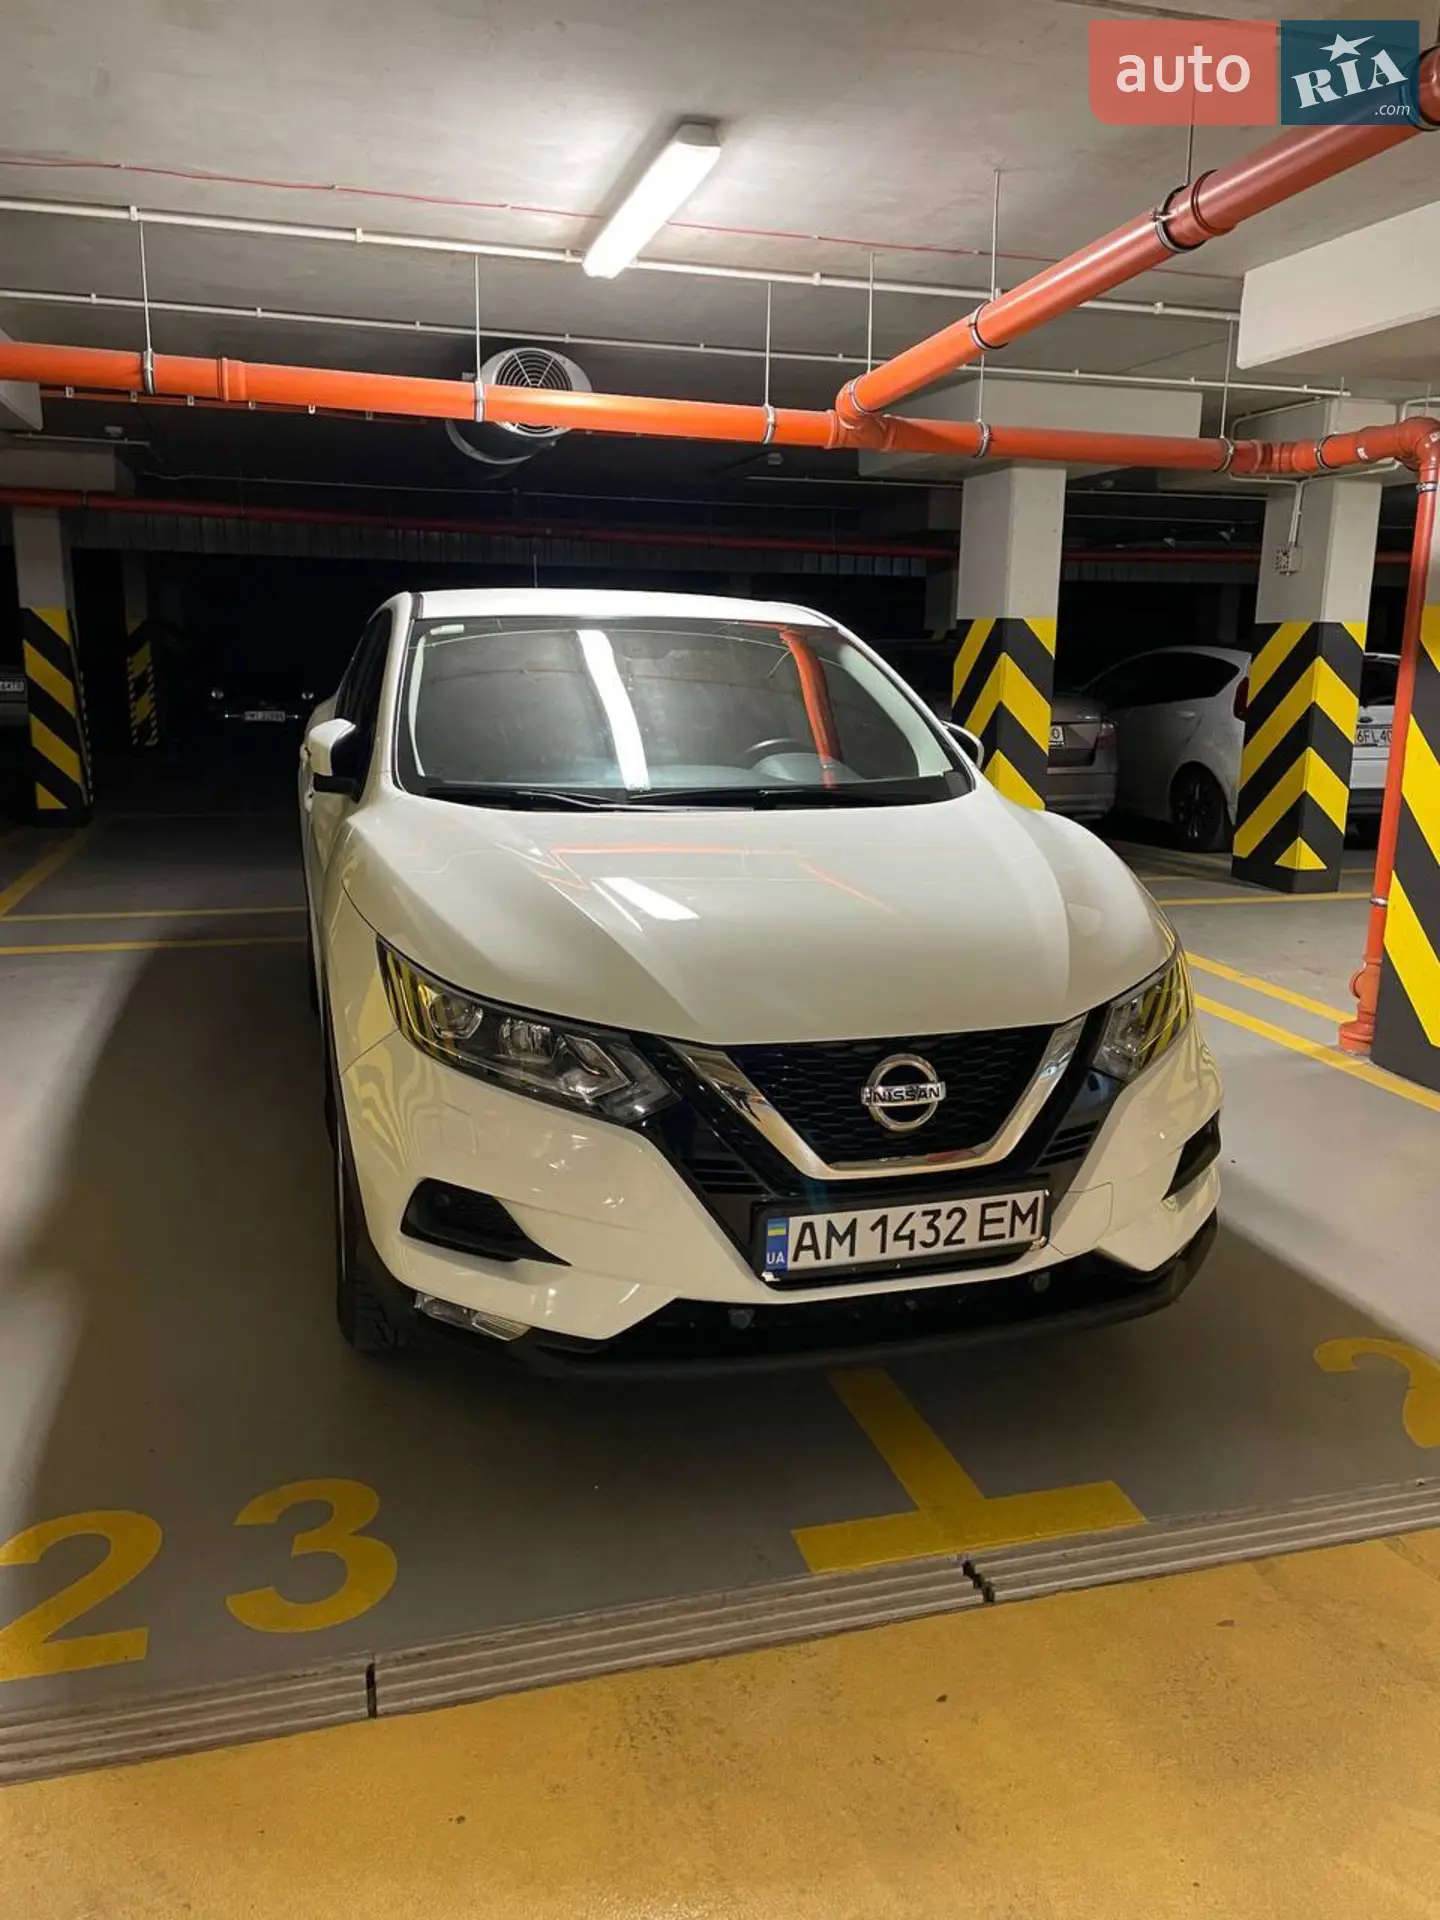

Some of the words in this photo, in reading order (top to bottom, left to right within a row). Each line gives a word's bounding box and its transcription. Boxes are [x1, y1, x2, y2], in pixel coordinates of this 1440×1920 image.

[873, 1087, 940, 1103] NISSAN
[791, 1217, 857, 1263] AM
[869, 1206, 967, 1255] 1432
[977, 1196, 1040, 1243] EM
[766, 1251, 785, 1265] UA
